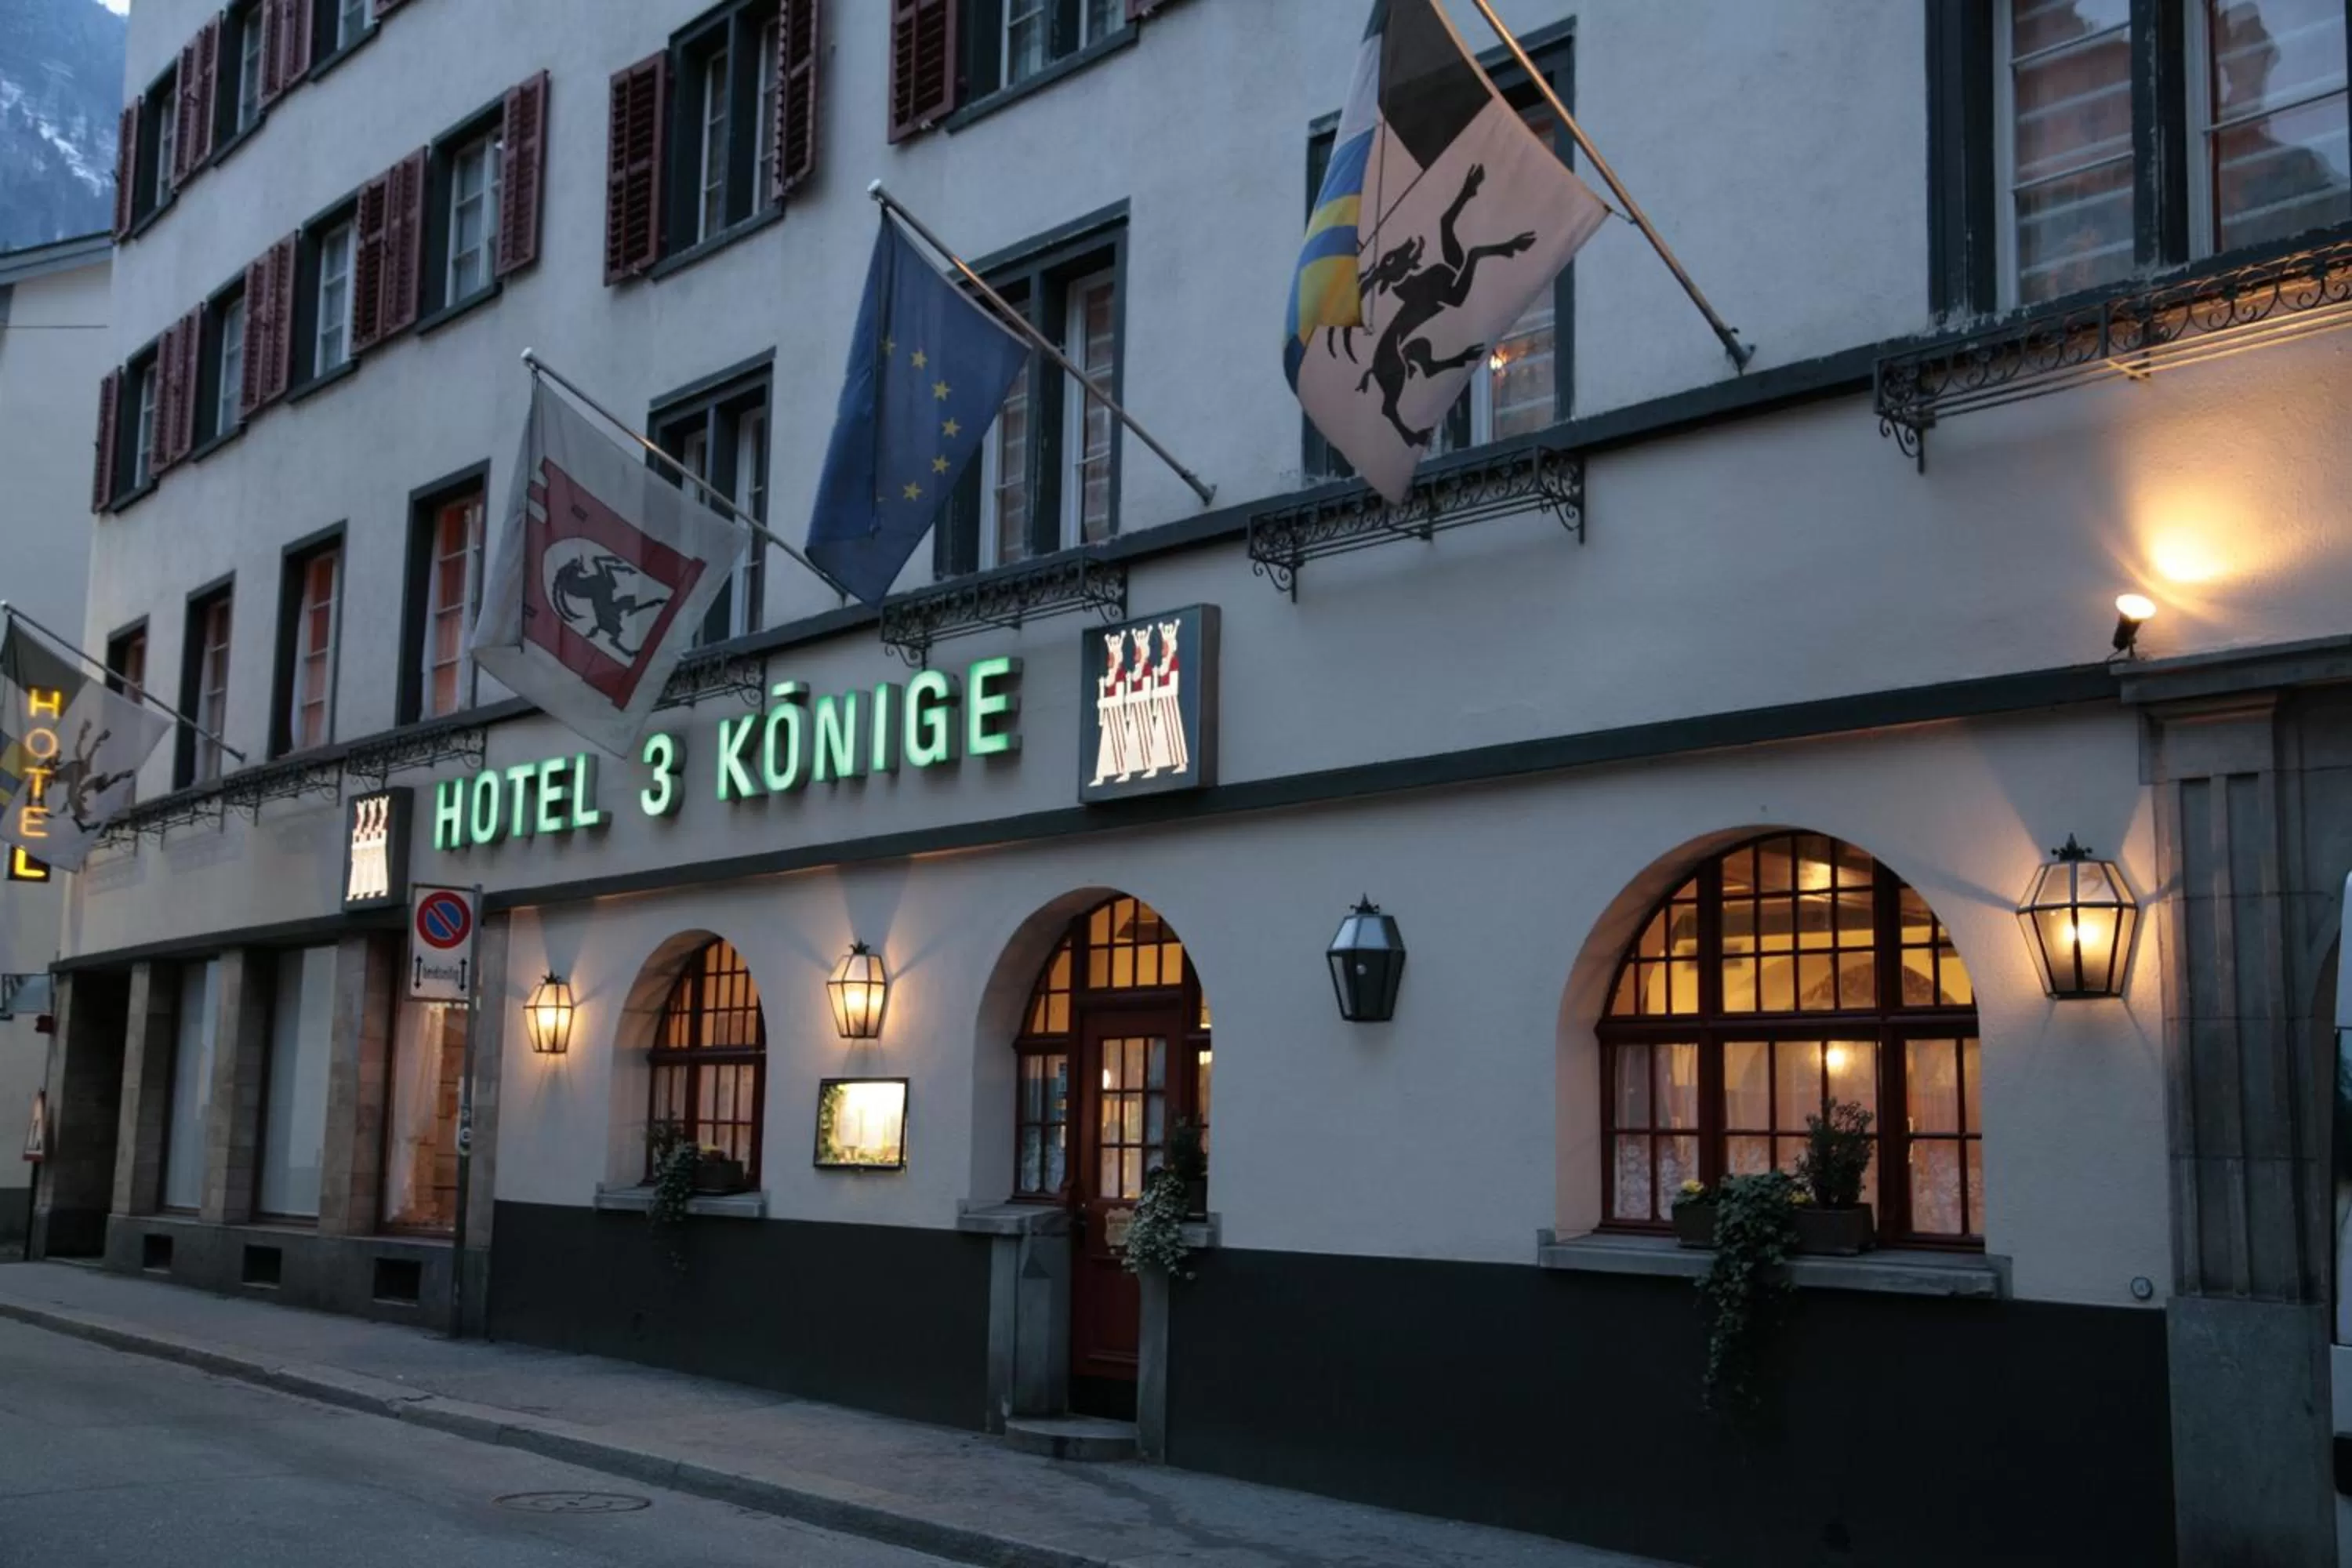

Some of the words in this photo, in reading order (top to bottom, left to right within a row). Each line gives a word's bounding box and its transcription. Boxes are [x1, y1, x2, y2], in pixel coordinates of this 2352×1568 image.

[20, 687, 63, 878] HOTEL
[433, 750, 603, 851] HOTEL
[639, 730, 681, 817] 3
